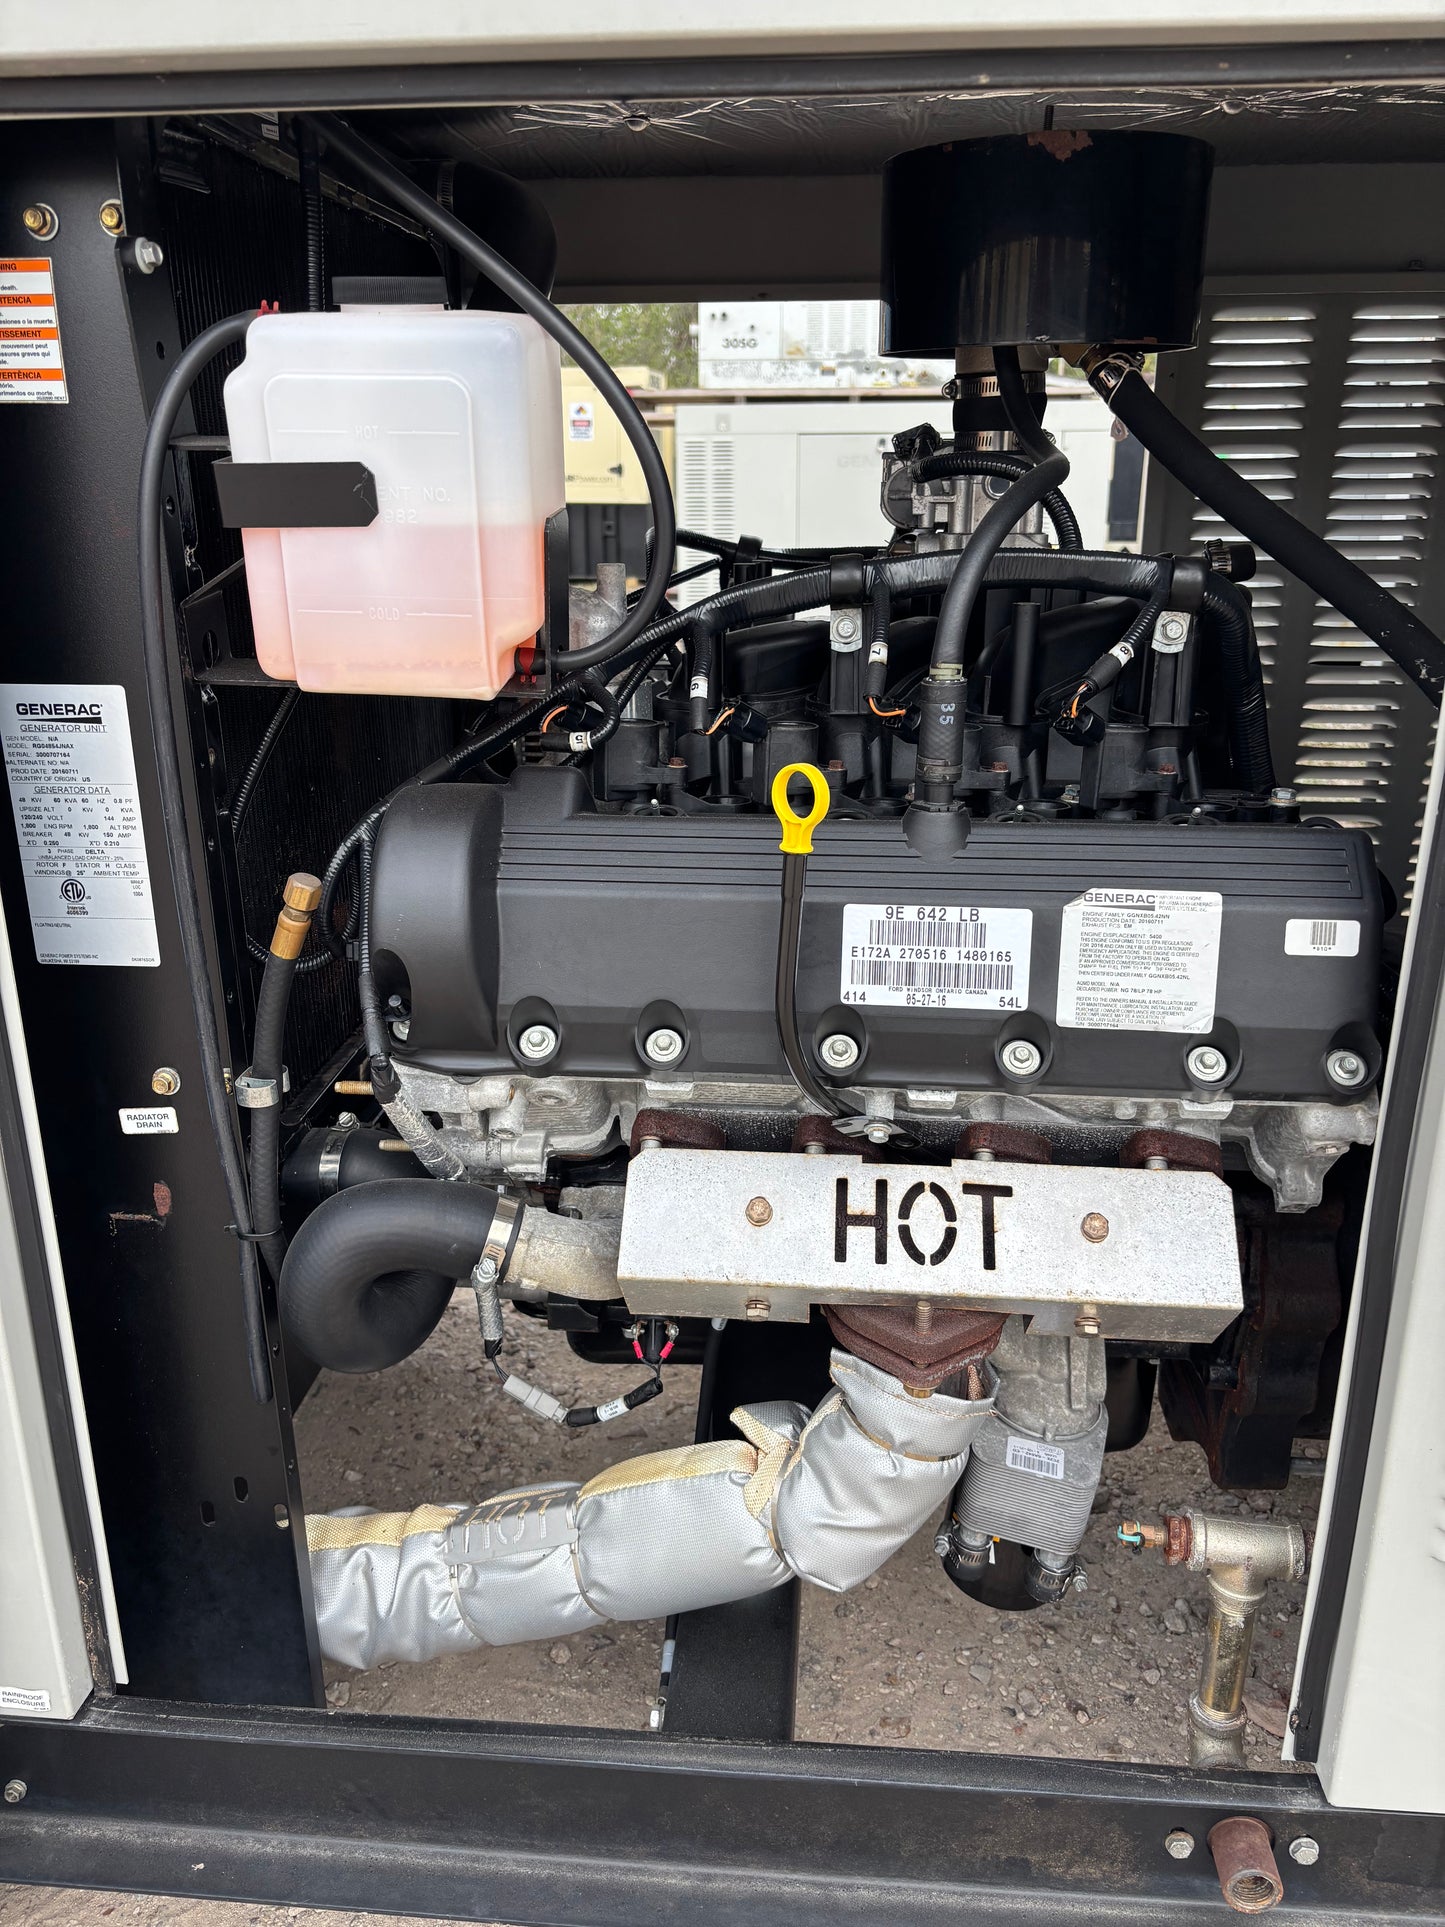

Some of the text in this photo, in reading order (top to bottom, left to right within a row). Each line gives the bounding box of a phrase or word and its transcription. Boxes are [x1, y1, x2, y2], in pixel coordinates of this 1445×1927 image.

[354, 425, 379, 439] HOT
[423, 487, 451, 502] NO.
[368, 607, 400, 620] COLD
[16, 703, 101, 716] GENERAC
[20, 724, 107, 733] GENERATOR UNIT
[575, 734, 583, 744] 5
[34, 786, 111, 795] GENERATOR DATA
[1084, 892, 1156, 904] GENERAC
[885, 905, 980, 922] 9E 642 LB
[851, 946, 1012, 963] E172A 270516 1480165
[843, 991, 1022, 1009] 414 05-27-16 54L
[126, 1113, 170, 1121] RADIATOR
[136, 1121, 163, 1129] DRAIN
[835, 1177, 1013, 1271] HOT
[463, 1491, 567, 1554] HOT
[2, 1690, 44, 1701] RAINPROOF
[2, 1697, 46, 1707] ENCLOSURE
